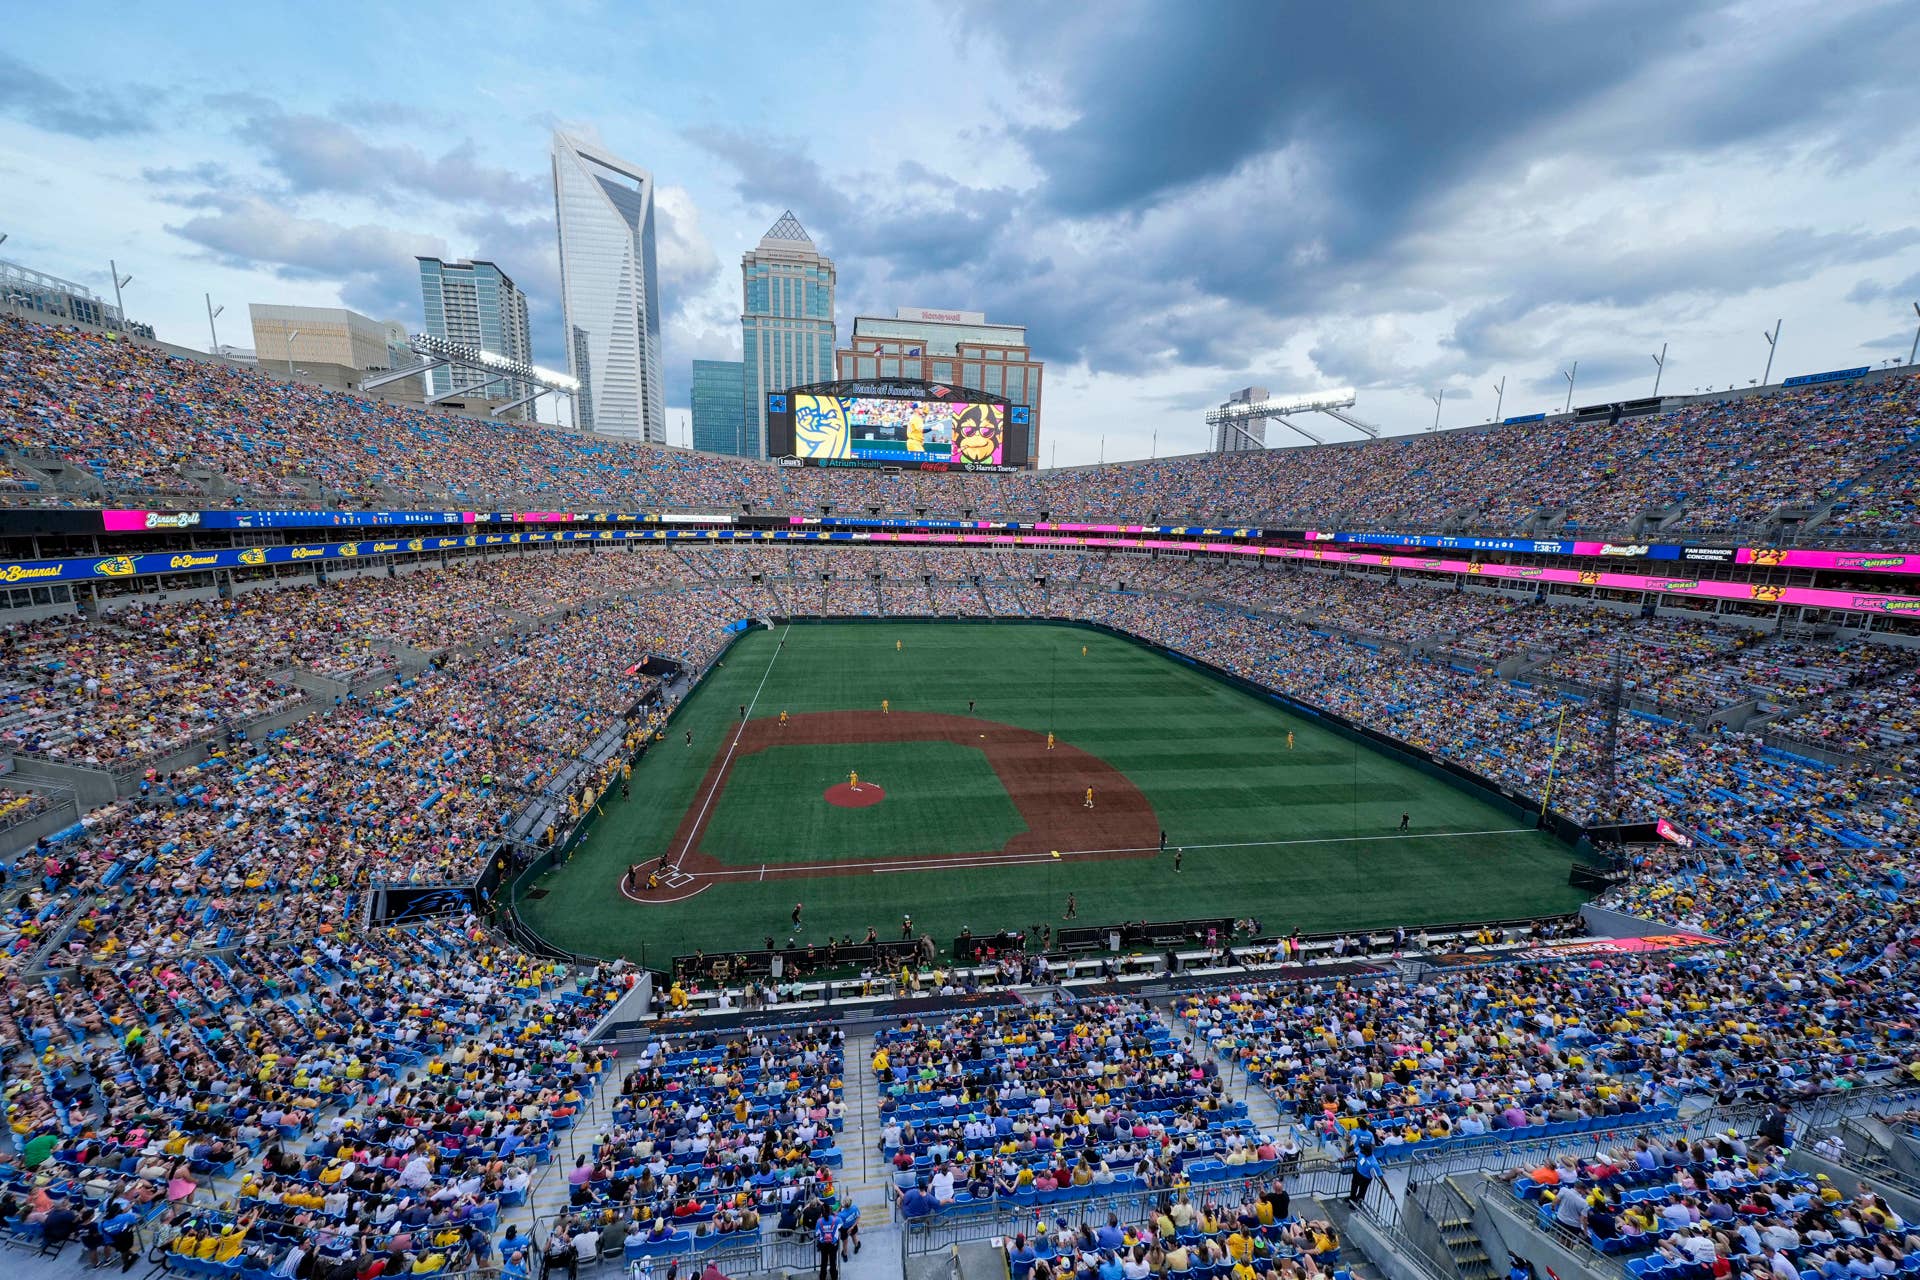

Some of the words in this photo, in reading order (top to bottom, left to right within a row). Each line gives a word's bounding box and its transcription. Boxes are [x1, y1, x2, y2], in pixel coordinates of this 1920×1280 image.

[921, 311, 960, 321] Honeywell
[852, 383, 876, 394] Bank
[877, 384, 888, 395] of
[888, 385, 926, 397] America
[829, 459, 857, 467] Atrium
[857, 459, 881, 468] Health
[976, 464, 997, 472] Harris
[997, 465, 1018, 473] Teeter
[1698, 548, 1732, 556] BEHAVIOR
[1864, 557, 1905, 568] ANIMALS
[6, 564, 63, 582] Bananas!
[1886, 600, 1920, 612] ANIMA
